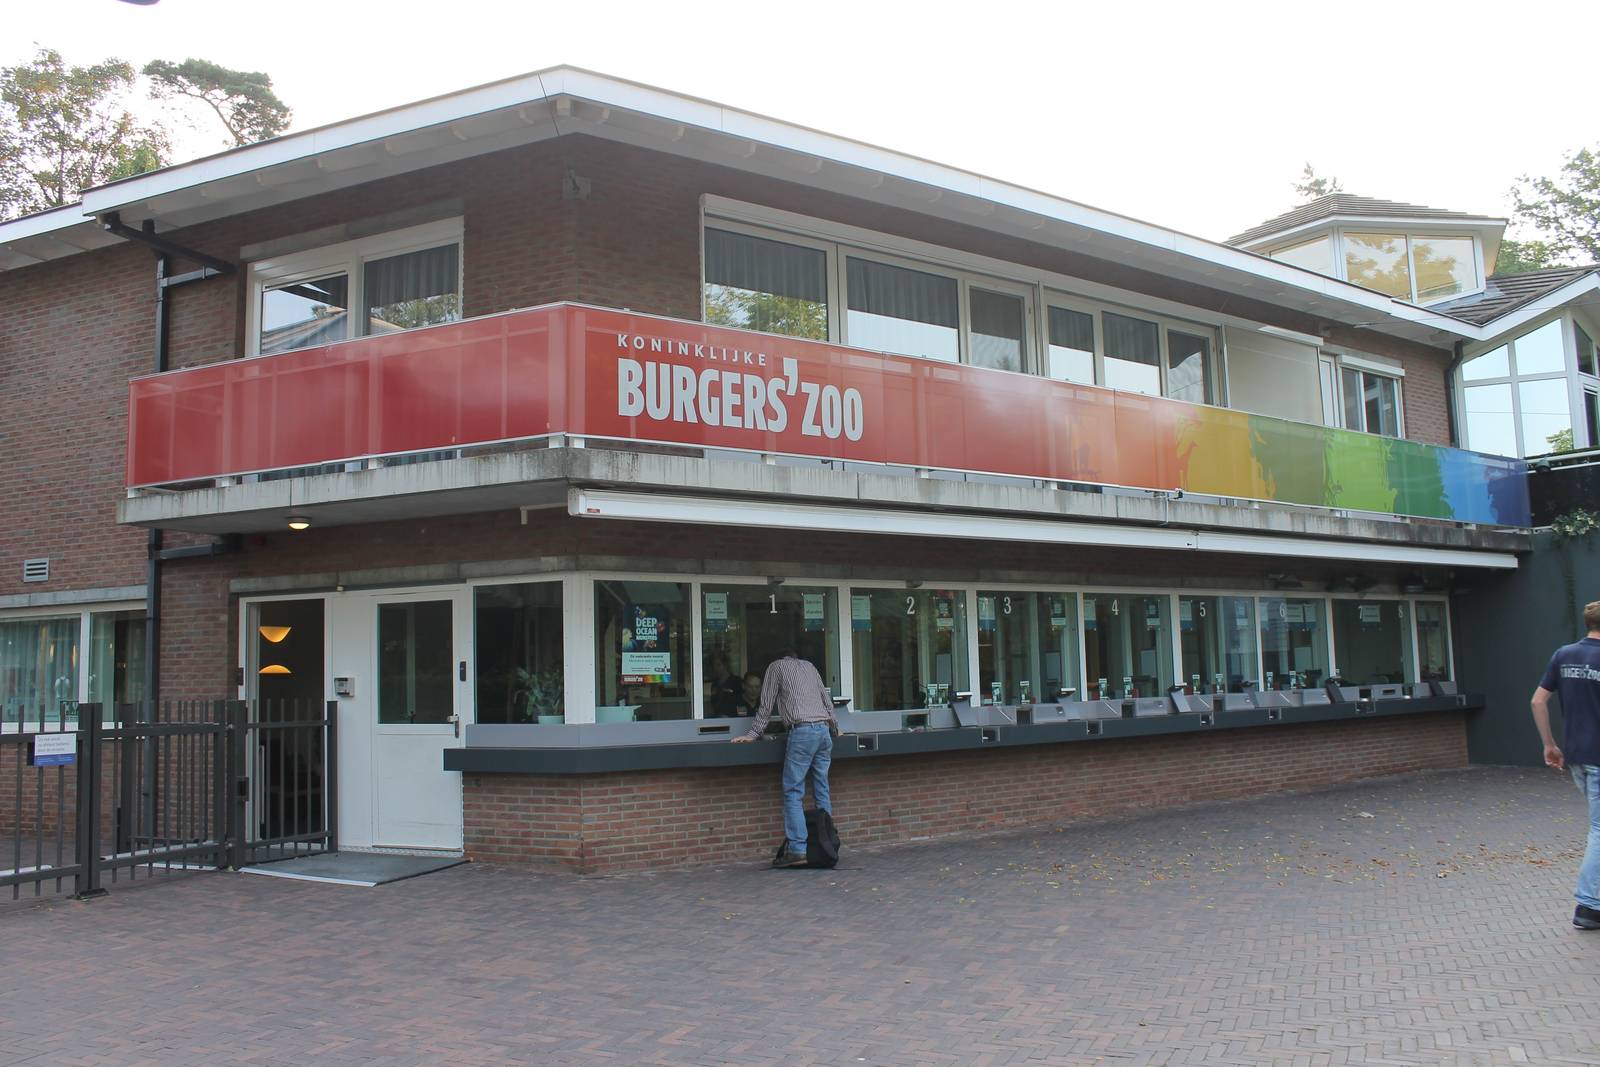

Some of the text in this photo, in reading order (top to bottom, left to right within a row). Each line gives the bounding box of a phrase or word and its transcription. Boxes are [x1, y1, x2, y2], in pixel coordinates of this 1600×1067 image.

[617, 334, 767, 366] KONINKLIJKE
[768, 593, 778, 614] 1
[906, 596, 915, 615] 2
[1003, 596, 1012, 615] 3
[1111, 599, 1120, 616] 4
[1199, 601, 1206, 617] 5
[1279, 602, 1286, 618] 6
[1398, 604, 1404, 619] 8
[635, 617, 657, 628] DEEP
